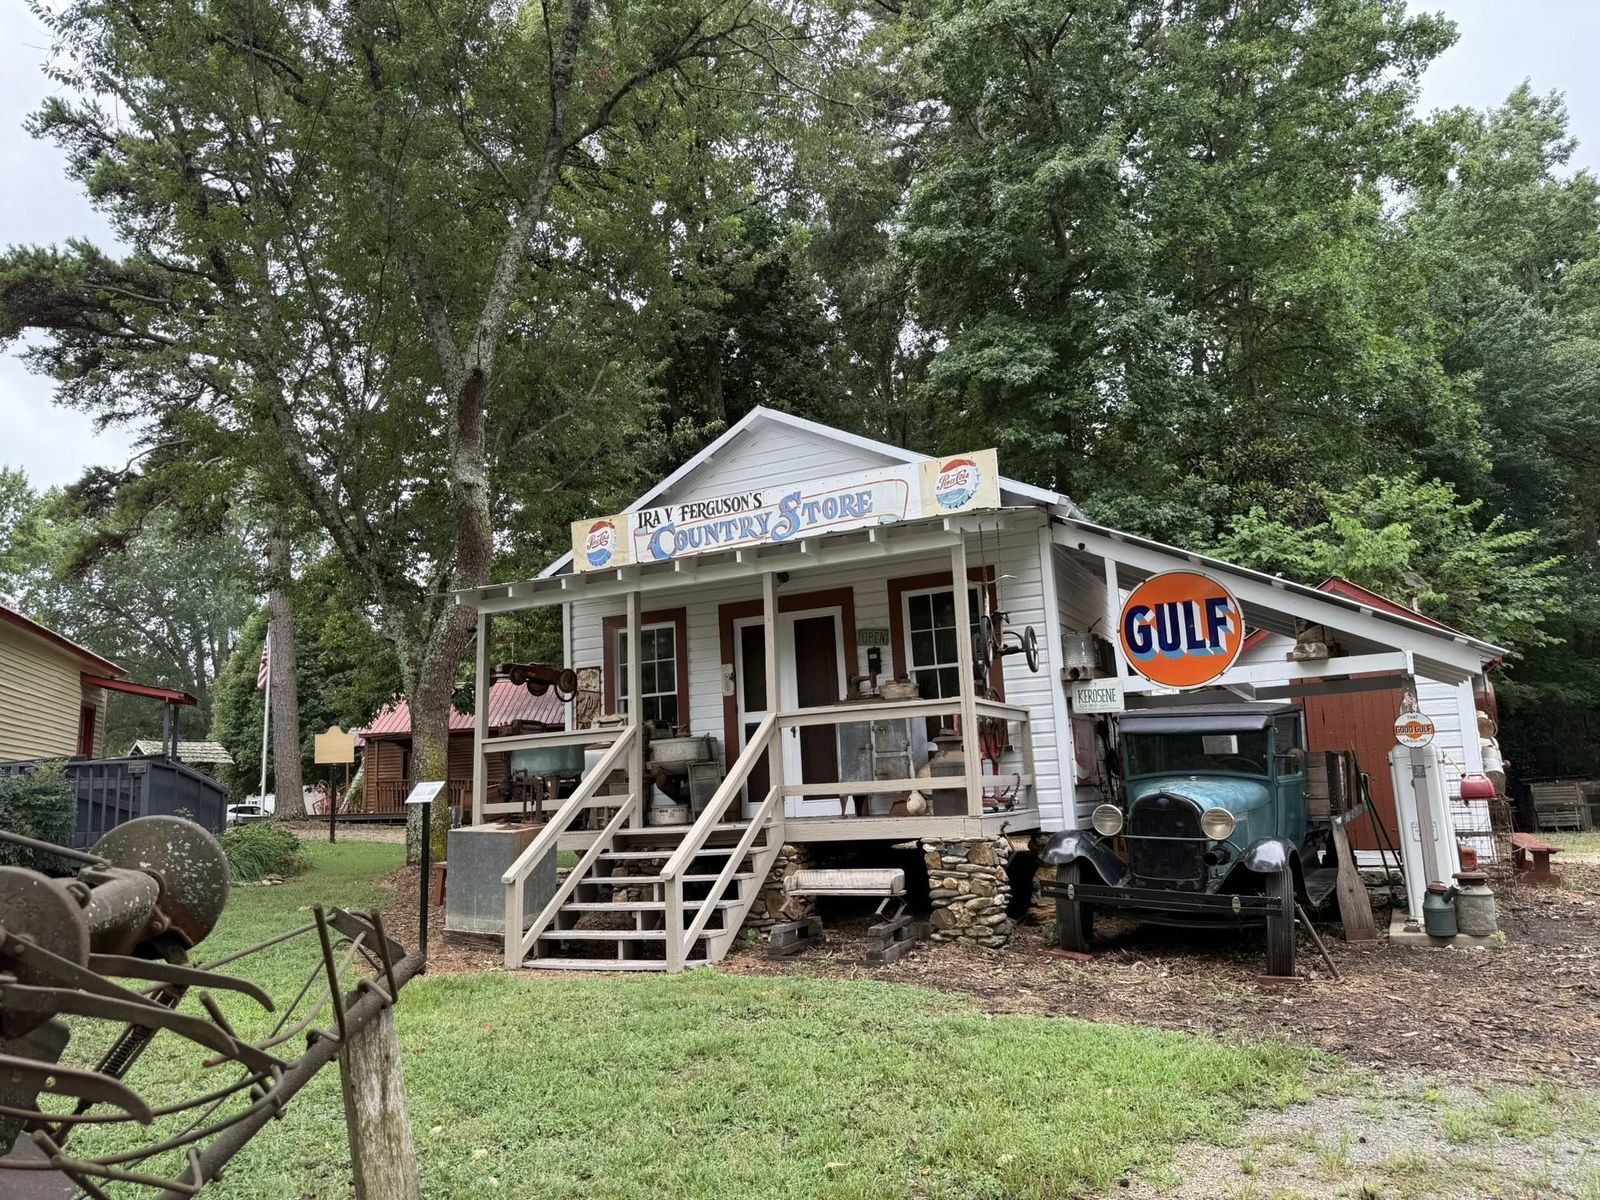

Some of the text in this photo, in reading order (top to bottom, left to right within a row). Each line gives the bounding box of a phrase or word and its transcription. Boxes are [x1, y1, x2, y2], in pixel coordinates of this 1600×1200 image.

[638, 492, 763, 528] IRA V. FERGUSON'S
[647, 491, 873, 560] COUNTRY STORE
[1124, 596, 1235, 661] GULF
[1077, 687, 1117, 703] KEROSENE
